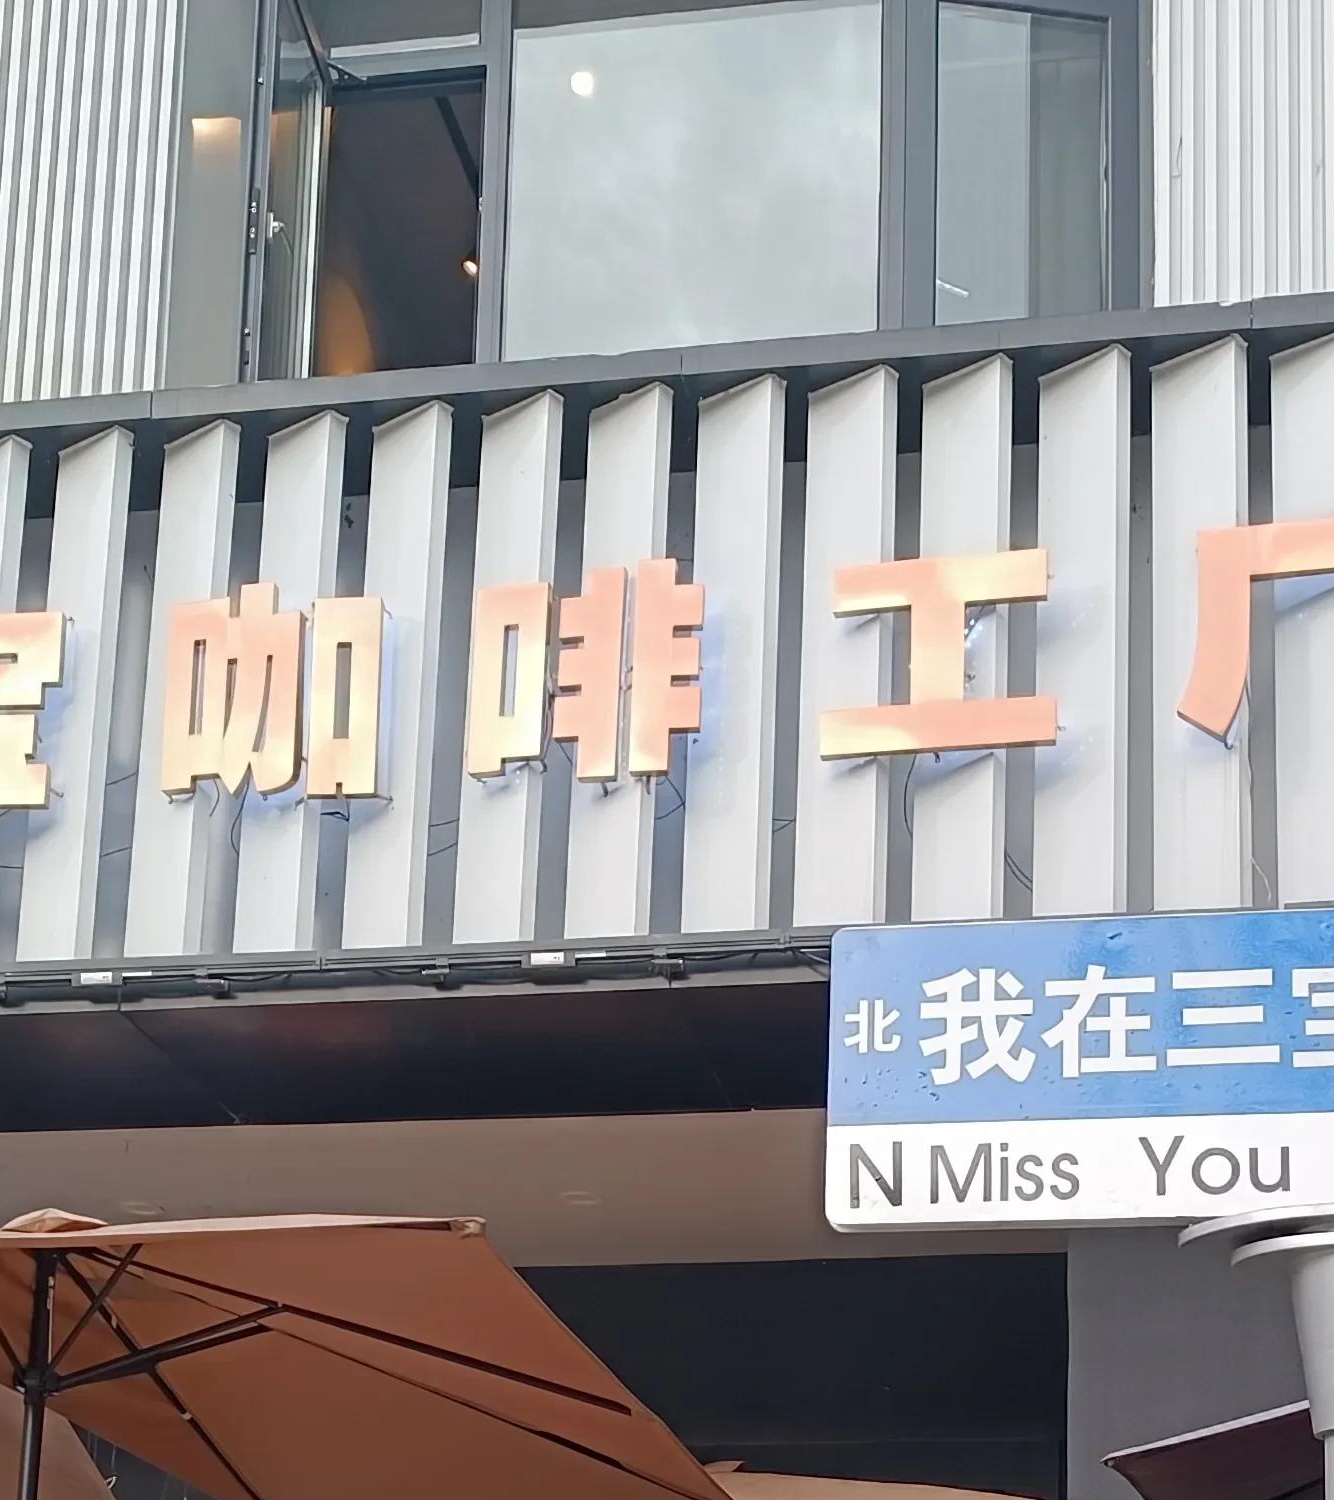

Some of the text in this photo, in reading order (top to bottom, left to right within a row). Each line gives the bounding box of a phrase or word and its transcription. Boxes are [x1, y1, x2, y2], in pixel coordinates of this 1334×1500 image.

[843, 997, 902, 1055] 北
[850, 1140, 905, 1209] N
[930, 1142, 1080, 1204] Miss
[1136, 1133, 1291, 1194] You
